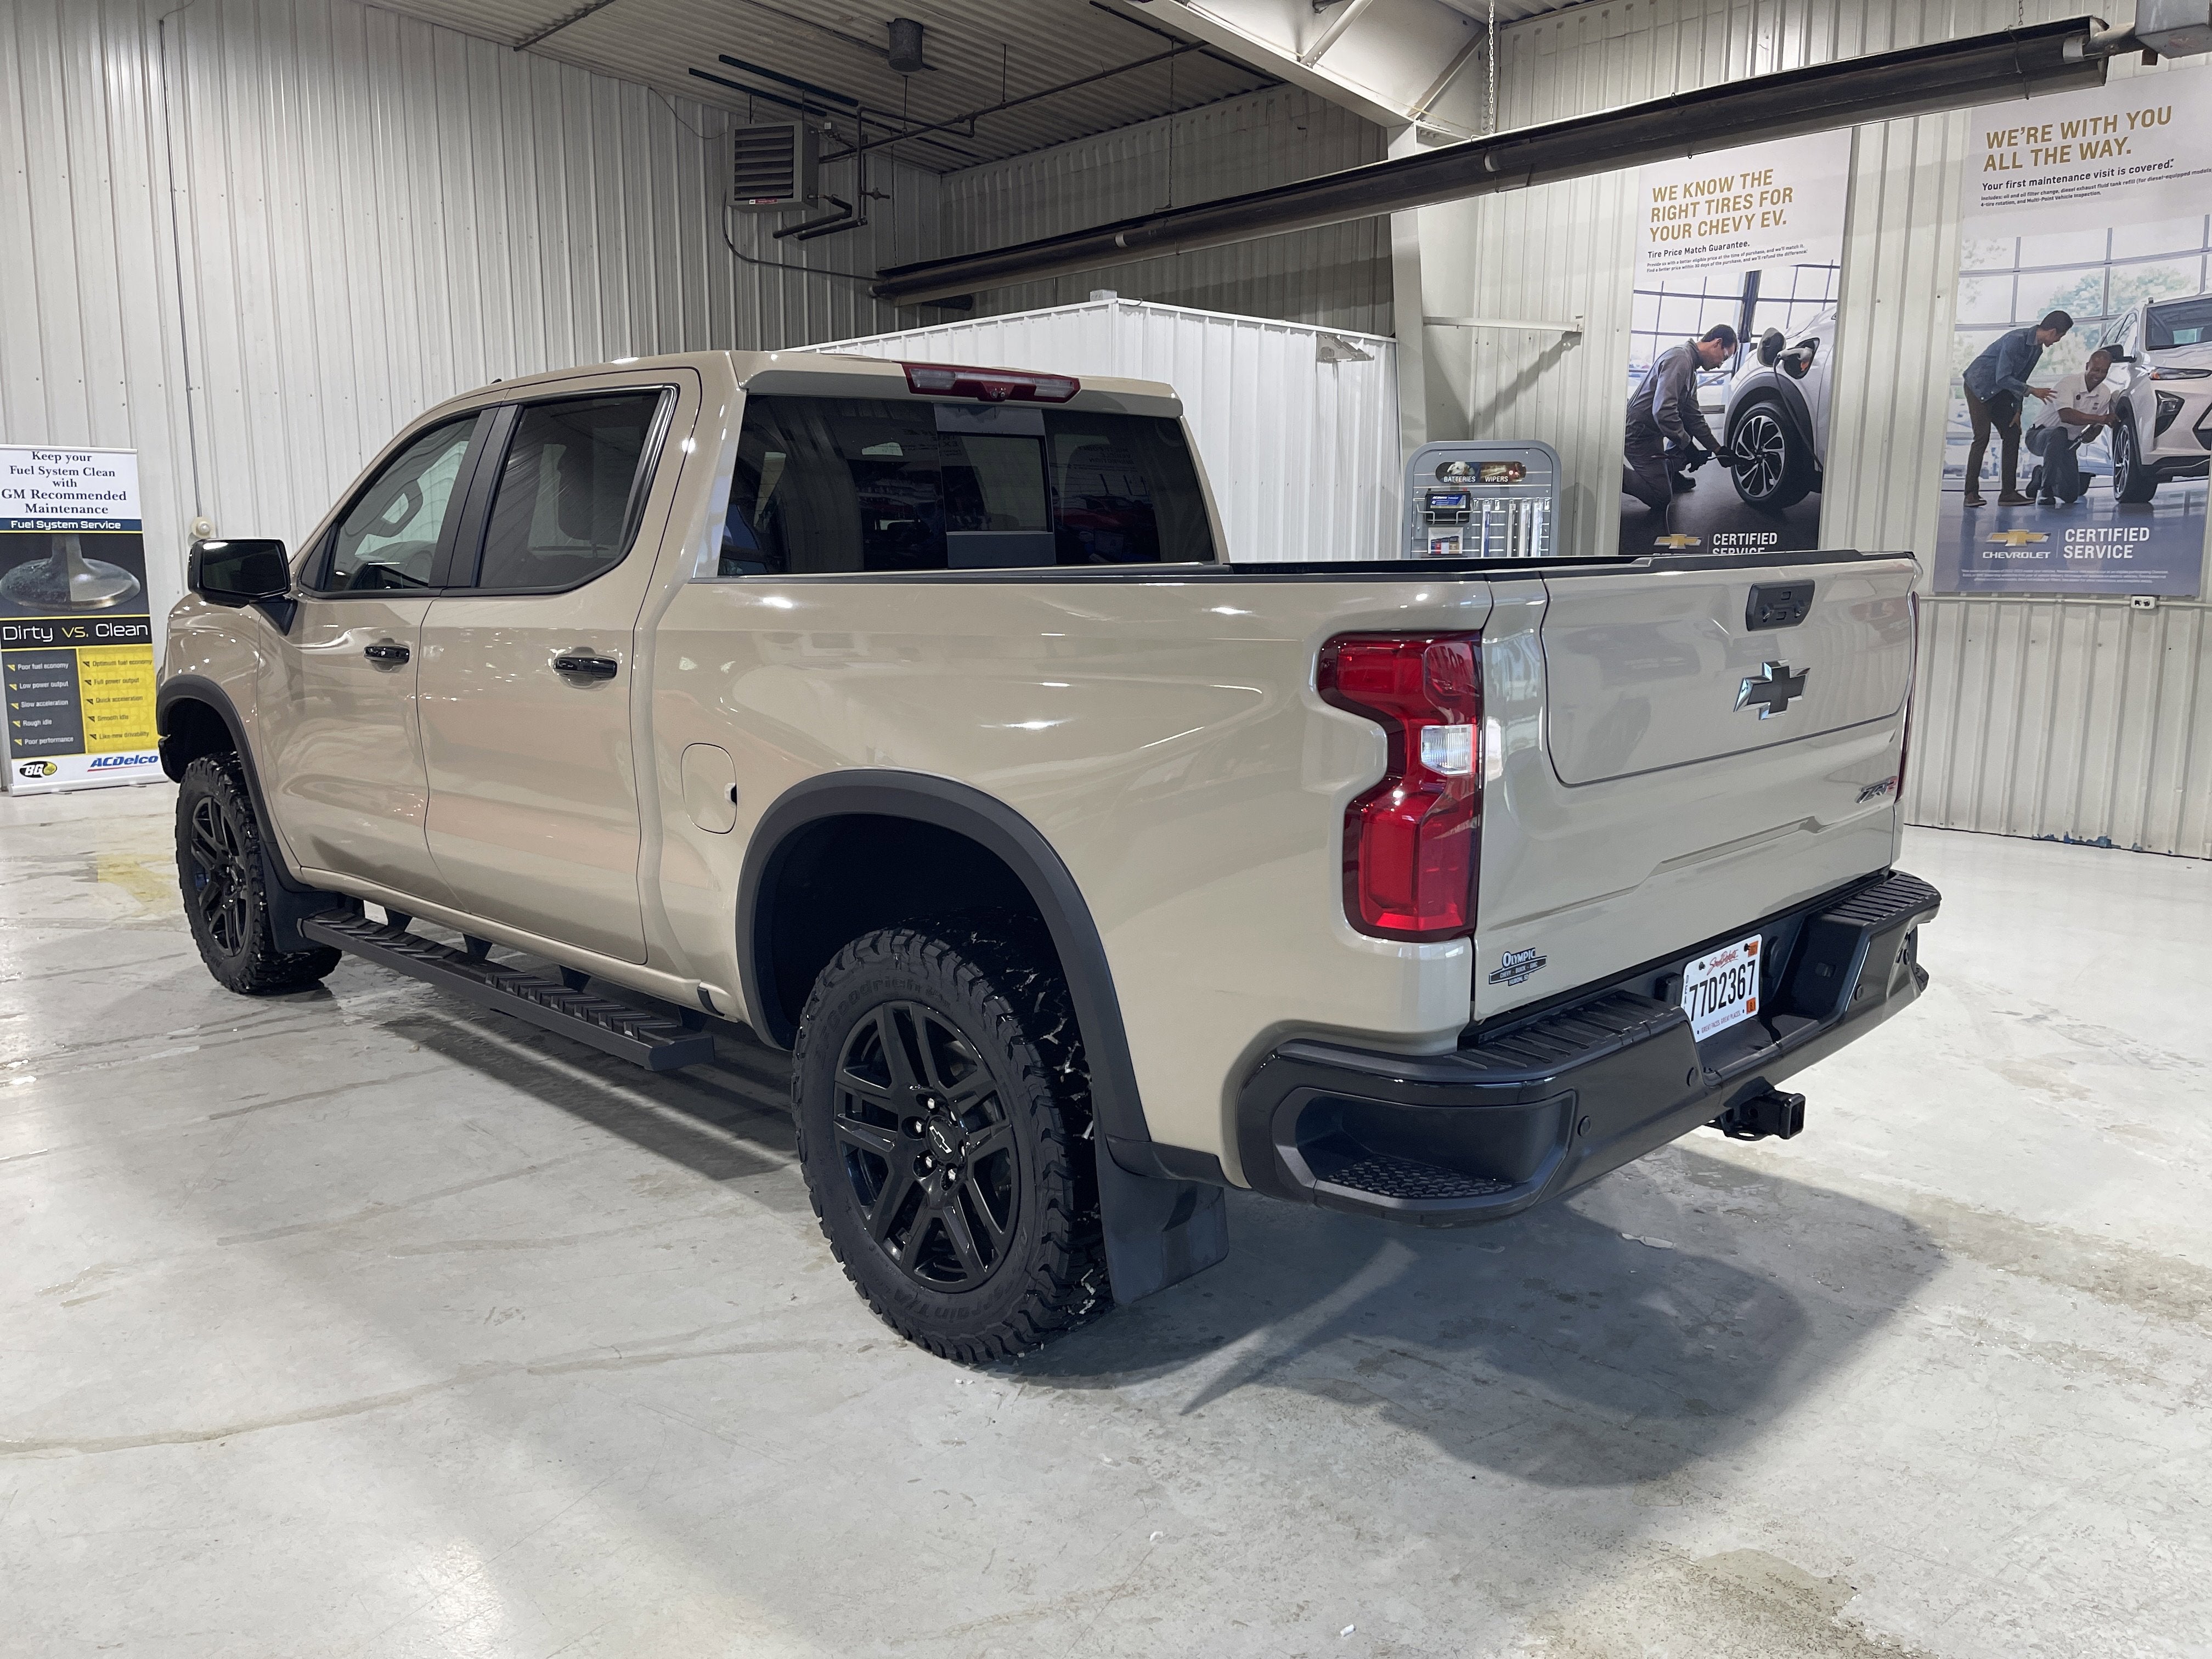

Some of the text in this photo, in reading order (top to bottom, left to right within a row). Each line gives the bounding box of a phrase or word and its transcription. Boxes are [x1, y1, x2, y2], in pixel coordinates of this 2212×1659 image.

[1987, 105, 2172, 149] WE'RE WITH YOU
[1983, 137, 2131, 172] ALL THE WAY.
[2006, 179, 2027, 189] first
[2029, 173, 2091, 187] maintenance
[2094, 168, 2114, 179] visit
[2118, 167, 2125, 176] is
[1652, 169, 1774, 202] WE KNOW THE
[1651, 187, 1793, 223] RIGHT TIRES FOR
[1650, 209, 1787, 242] YOUR CHEVY EV.
[1684, 245, 1707, 255] Match
[1709, 241, 1750, 252] Guarantee.
[32, 451, 92, 464] Keep your
[9, 465, 116, 479] Fuel System Clean
[52, 478, 77, 487] with
[1, 489, 127, 501] GM Recommended
[25, 503, 109, 514] Maintenance
[11, 520, 121, 531] Fuel System Service
[1713, 532, 1778, 545] CERTIFIED
[2064, 527, 2150, 543] CERTIFIED
[2063, 545, 2134, 559] SERVICE
[3, 623, 148, 642] Dirty vs. Clean
[43, 662, 69, 670] economy
[22, 719, 41, 727] Rough
[39, 736, 74, 745] performance
[23, 755, 159, 776] BG ACDelco
[1503, 949, 1536, 967] OLYMPIC
[1689, 960, 1756, 1022] 77D2367
